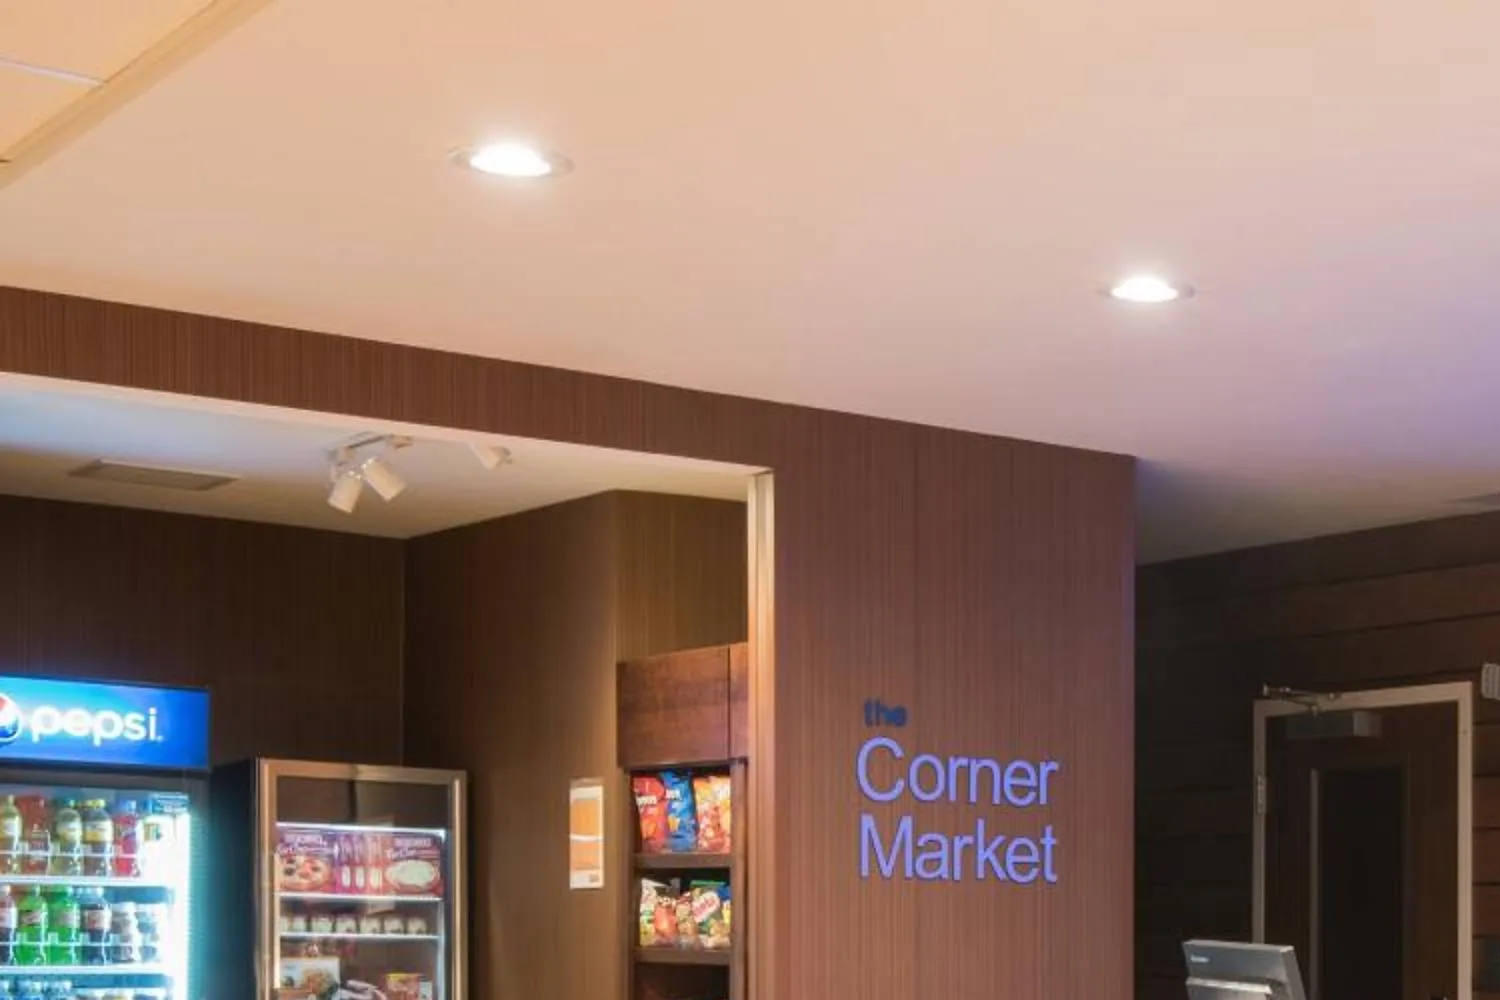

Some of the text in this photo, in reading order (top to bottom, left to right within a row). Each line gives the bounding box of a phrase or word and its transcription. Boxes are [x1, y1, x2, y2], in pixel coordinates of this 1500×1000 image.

[30, 705, 158, 747] pepsi
[864, 699, 907, 727] the
[855, 735, 1059, 807] Corner
[859, 812, 1058, 884] Market
